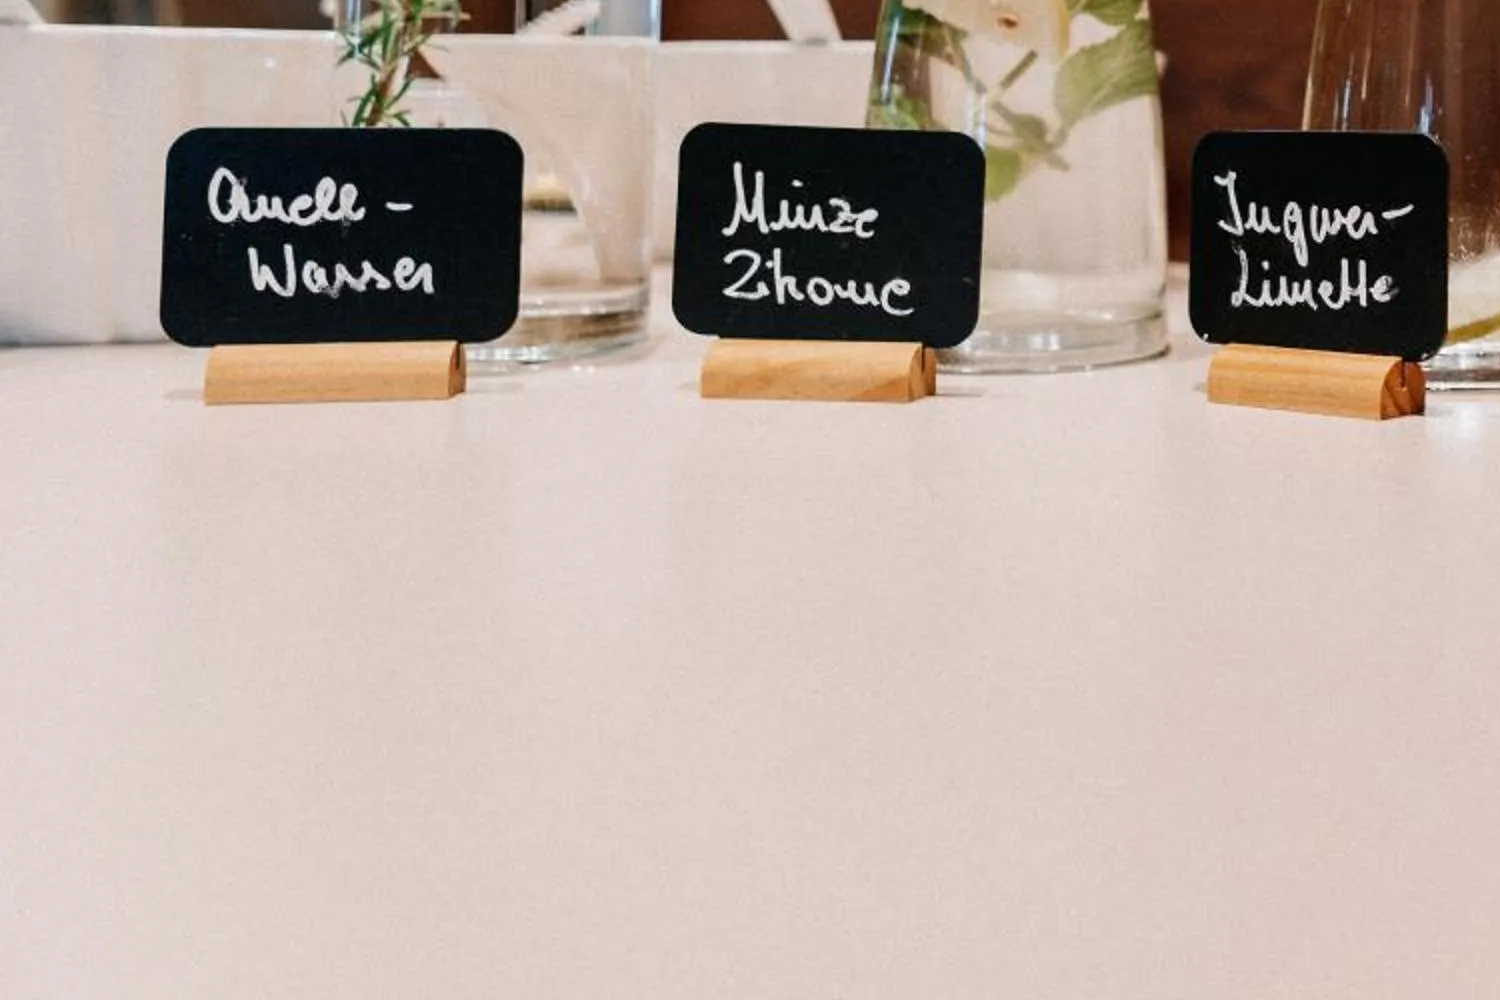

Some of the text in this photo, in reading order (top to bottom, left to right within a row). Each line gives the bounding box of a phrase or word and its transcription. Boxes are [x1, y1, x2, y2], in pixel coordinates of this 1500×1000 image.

[721, 161, 879, 238] Minze
[247, 243, 435, 298] Wasser
[722, 247, 915, 316] Zitrone
[1231, 247, 1394, 310] Limette
